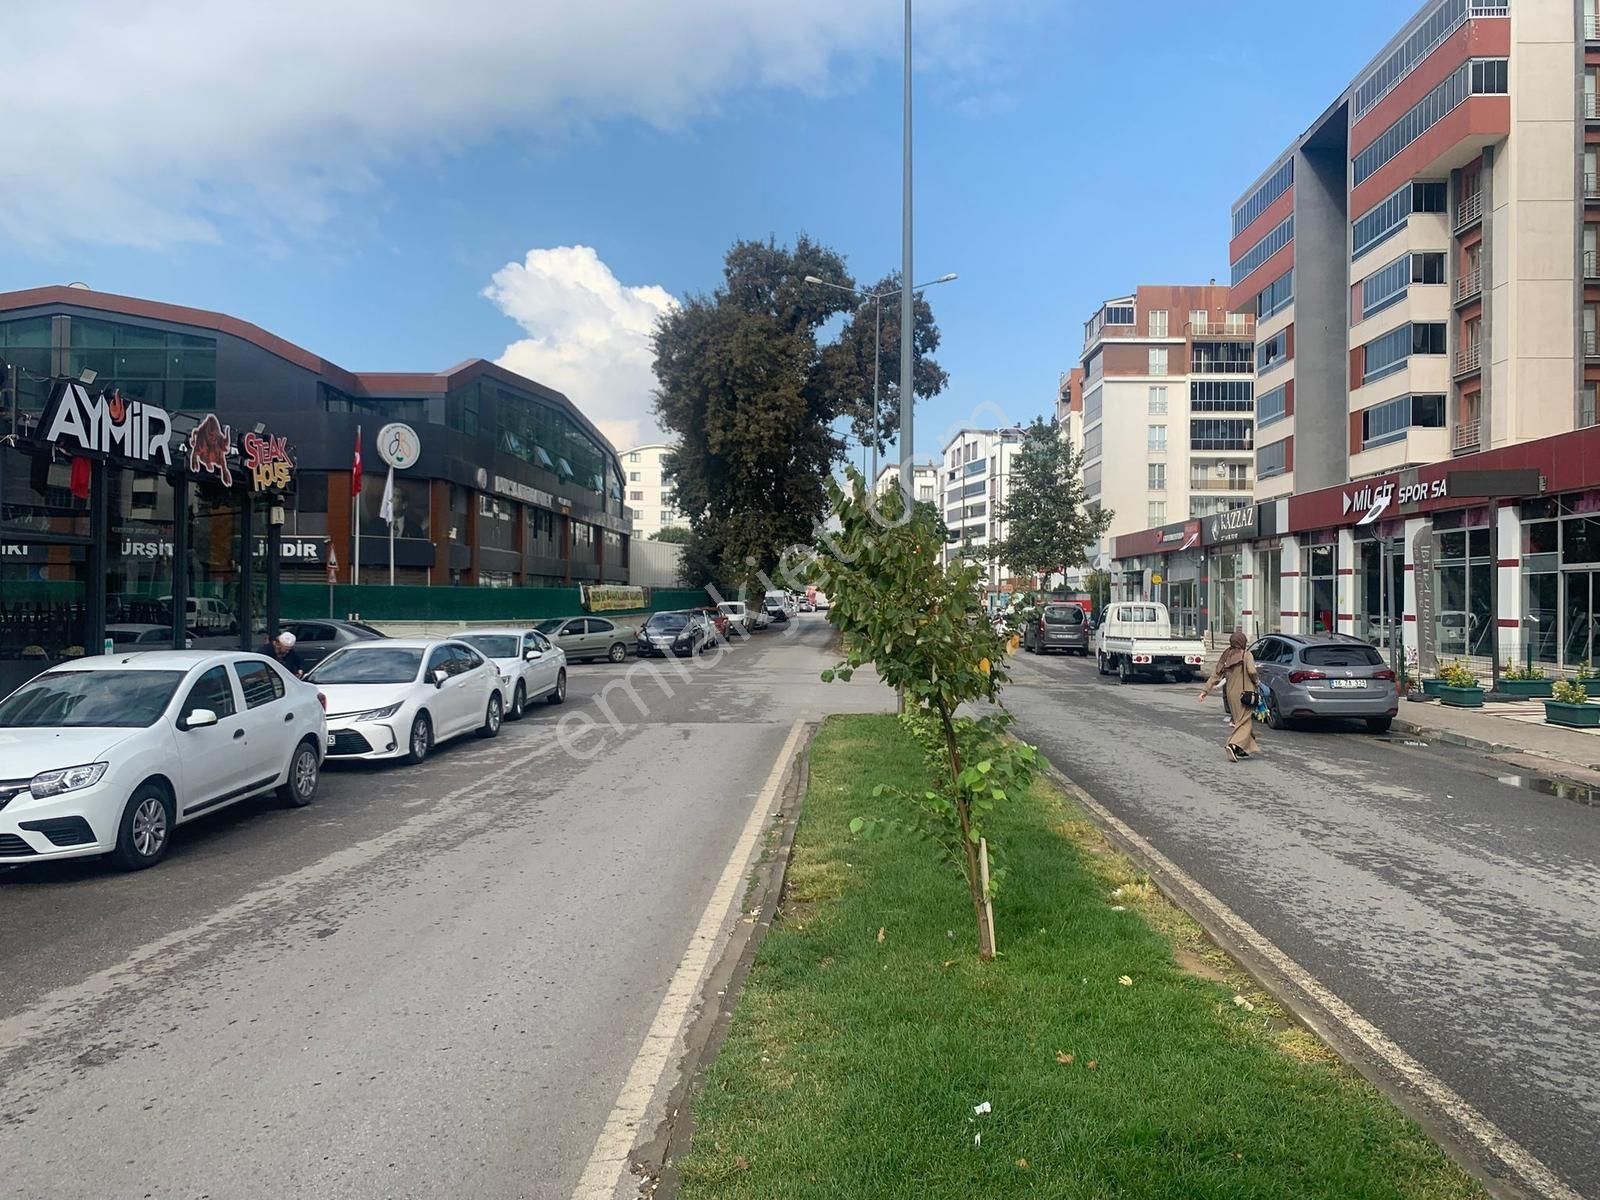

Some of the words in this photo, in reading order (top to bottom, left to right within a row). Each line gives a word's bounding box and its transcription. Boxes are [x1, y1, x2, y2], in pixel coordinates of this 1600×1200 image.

[244, 432, 293, 470] STEAK
[253, 462, 291, 492] HOUSE
[1398, 483, 1428, 504] SPOR
[1431, 479, 1447, 498] SA
